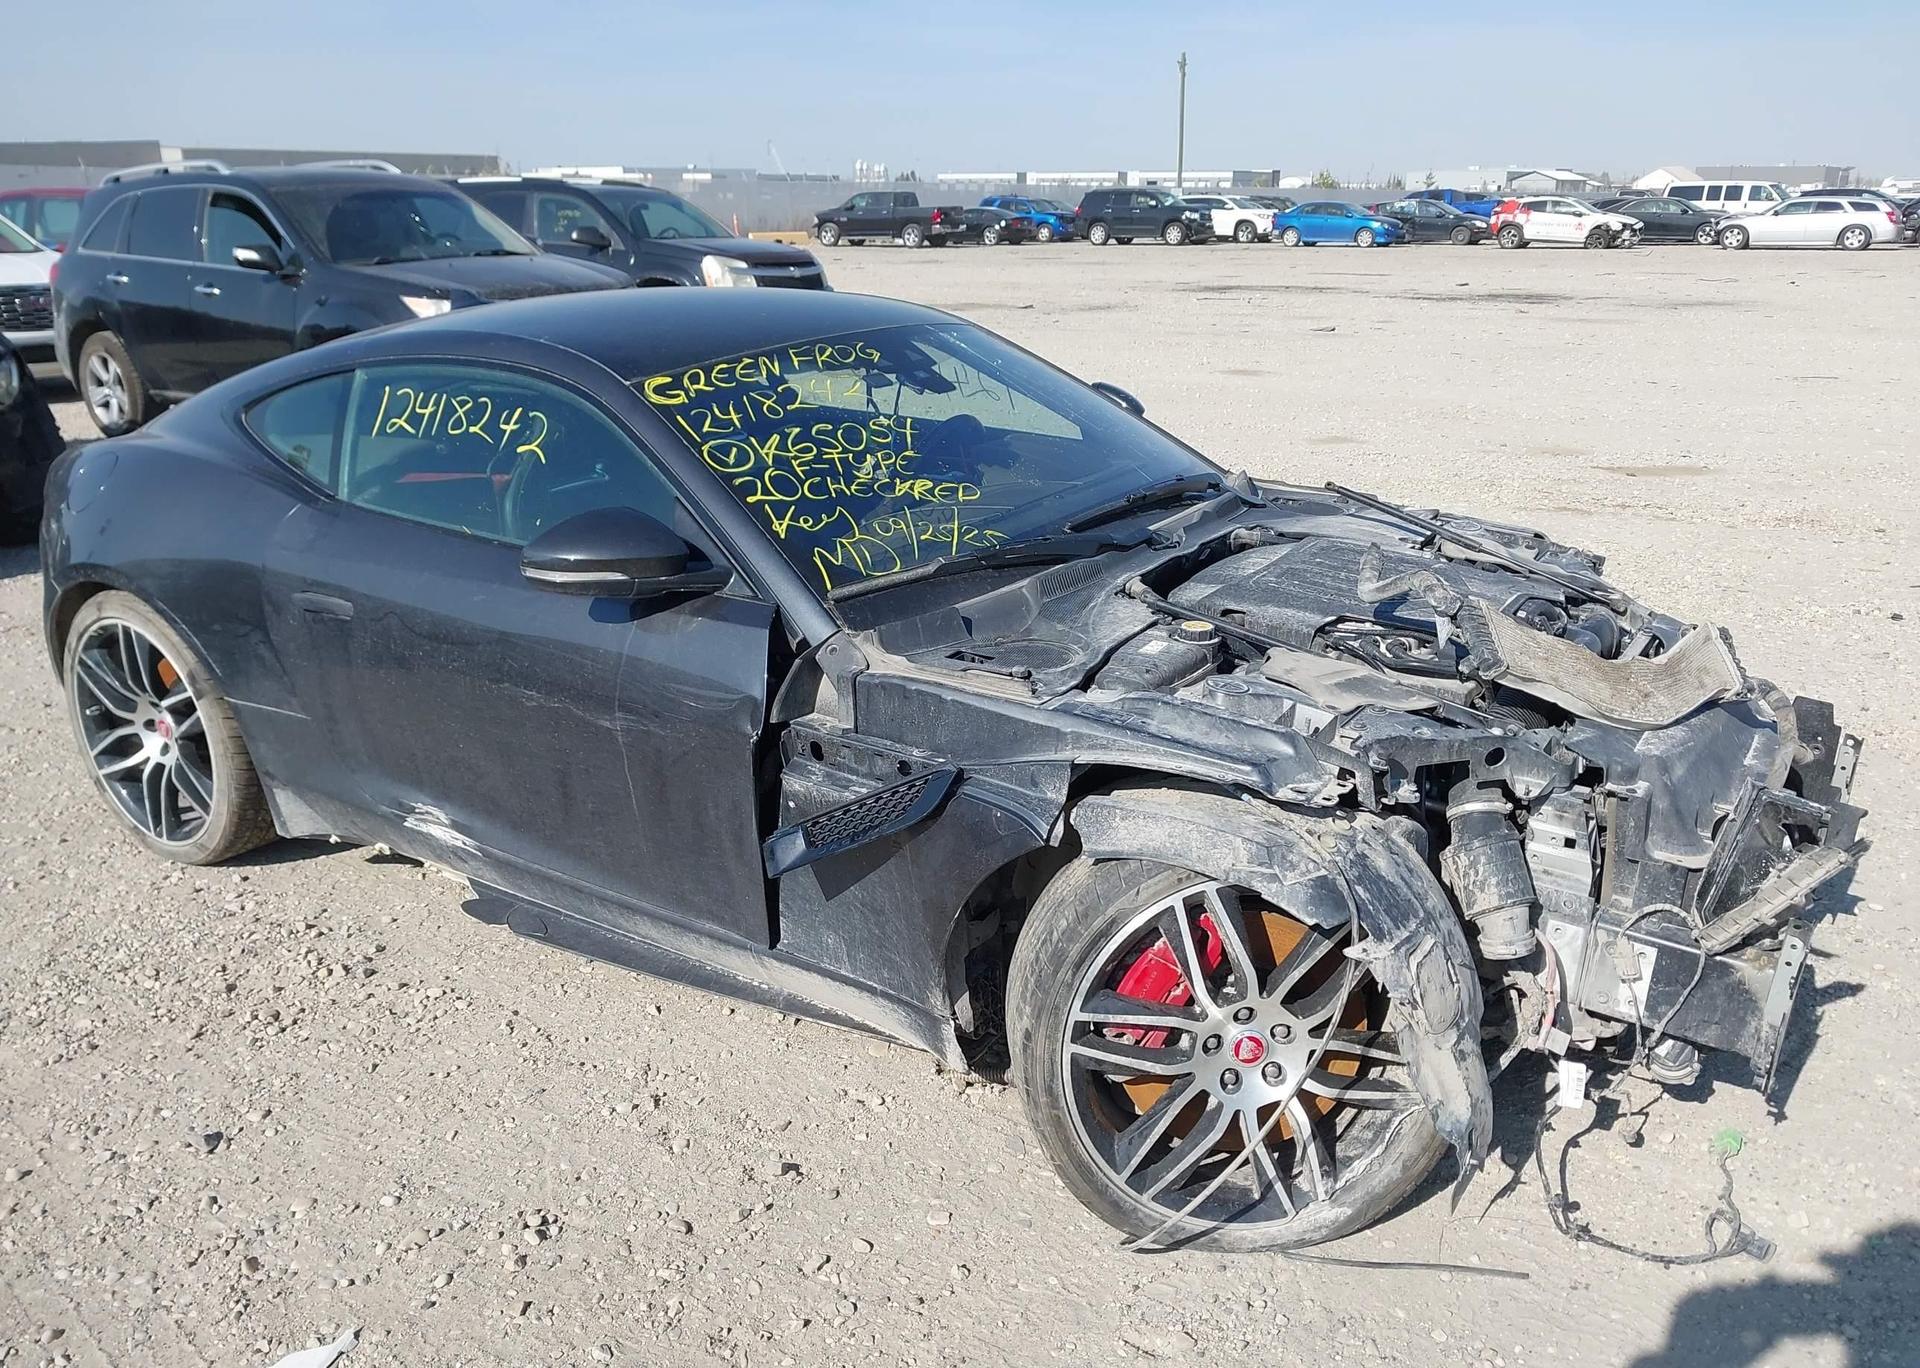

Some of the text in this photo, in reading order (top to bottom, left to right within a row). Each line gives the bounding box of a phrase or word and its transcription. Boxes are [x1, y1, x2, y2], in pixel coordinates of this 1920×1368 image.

[643, 342, 881, 404] GREEN FROG
[371, 384, 549, 465] 12418242
[732, 467, 802, 503] 20
